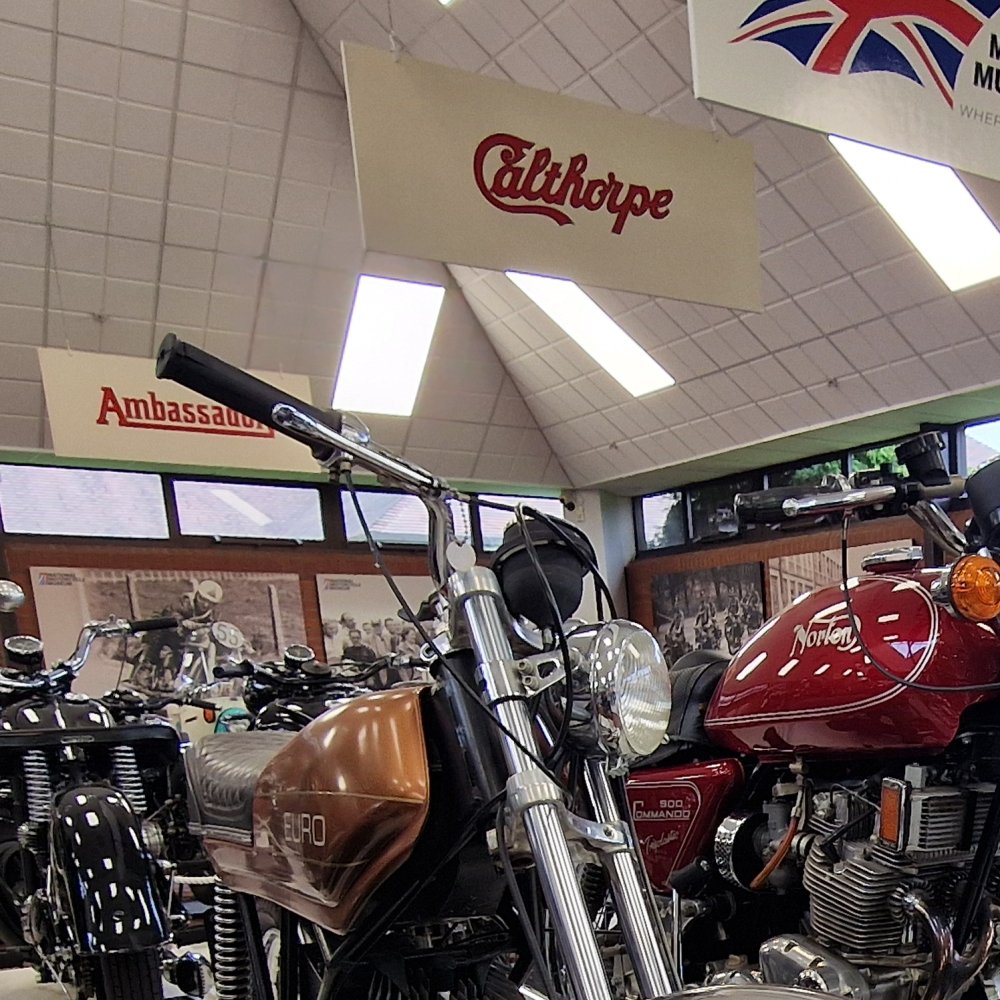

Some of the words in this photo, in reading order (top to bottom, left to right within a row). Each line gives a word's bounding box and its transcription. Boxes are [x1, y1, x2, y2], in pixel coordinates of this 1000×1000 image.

[473, 133, 674, 235] Calthorpe
[789, 614, 862, 657] Norton
[283, 812, 326, 847] EURO
[632, 800, 691, 821] COMMANDO
